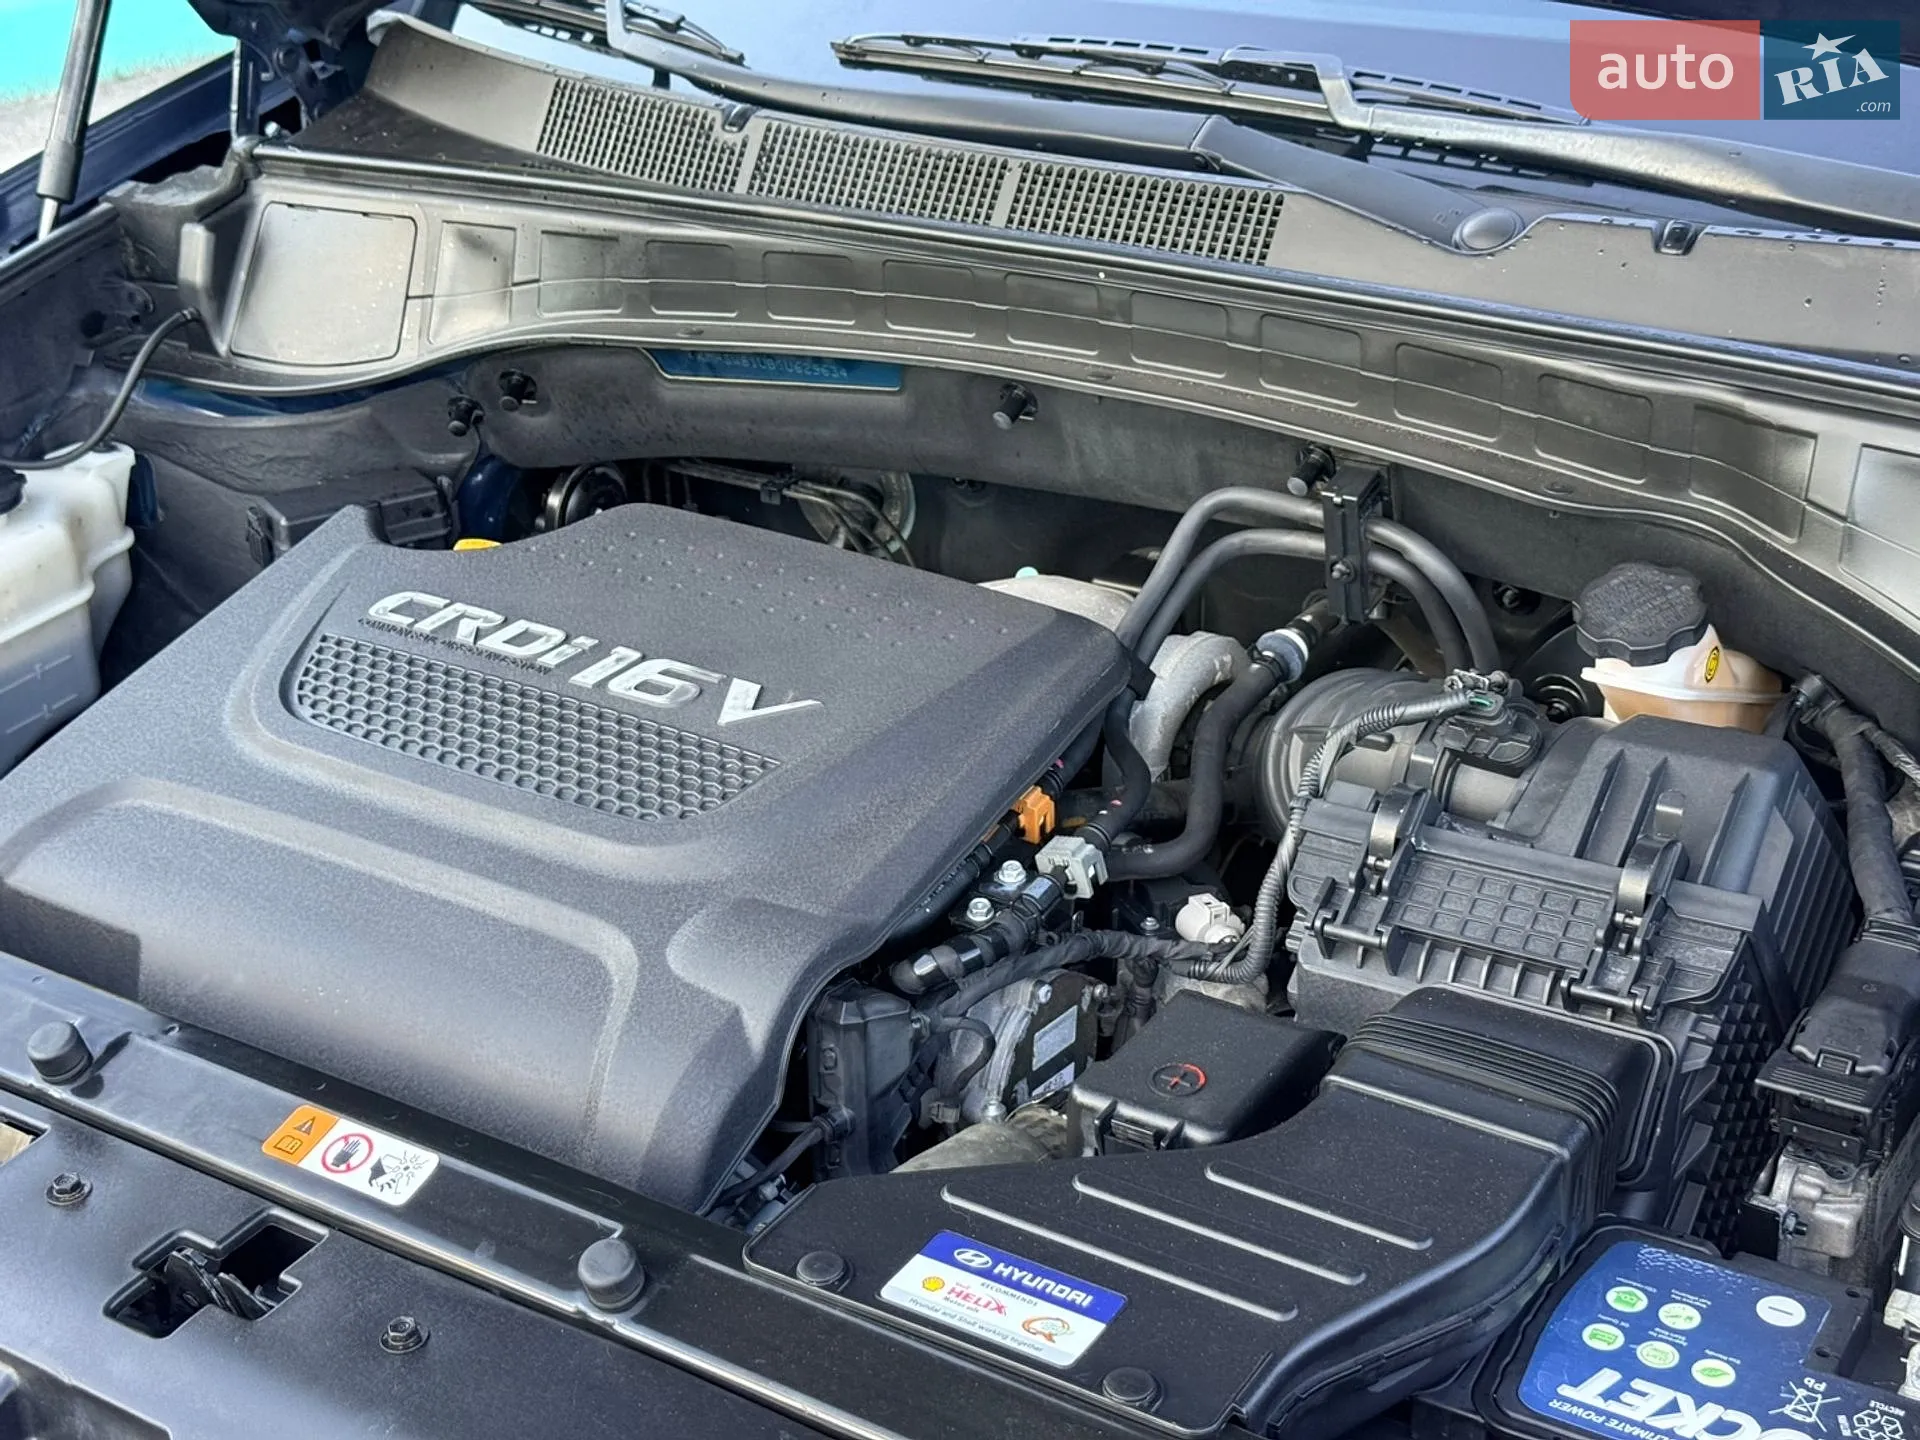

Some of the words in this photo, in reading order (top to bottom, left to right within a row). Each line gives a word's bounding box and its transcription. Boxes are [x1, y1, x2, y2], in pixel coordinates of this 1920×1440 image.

[368, 591, 599, 668] CRDi
[980, 1281, 1038, 1307] RECOMMENDS
[992, 1262, 1096, 1309] HYUNDAI
[947, 1286, 1007, 1316] HELIX
[908, 1297, 941, 1314] Hyundai
[941, 1310, 958, 1320] and
[957, 1316, 979, 1327] Shell
[978, 1322, 1009, 1341] working
[1010, 1335, 1045, 1354] together
[1803, 1377, 1827, 1392] Pb
[1547, 1398, 1607, 1424] POWER
[1867, 1399, 1906, 1417] RECYCLE
